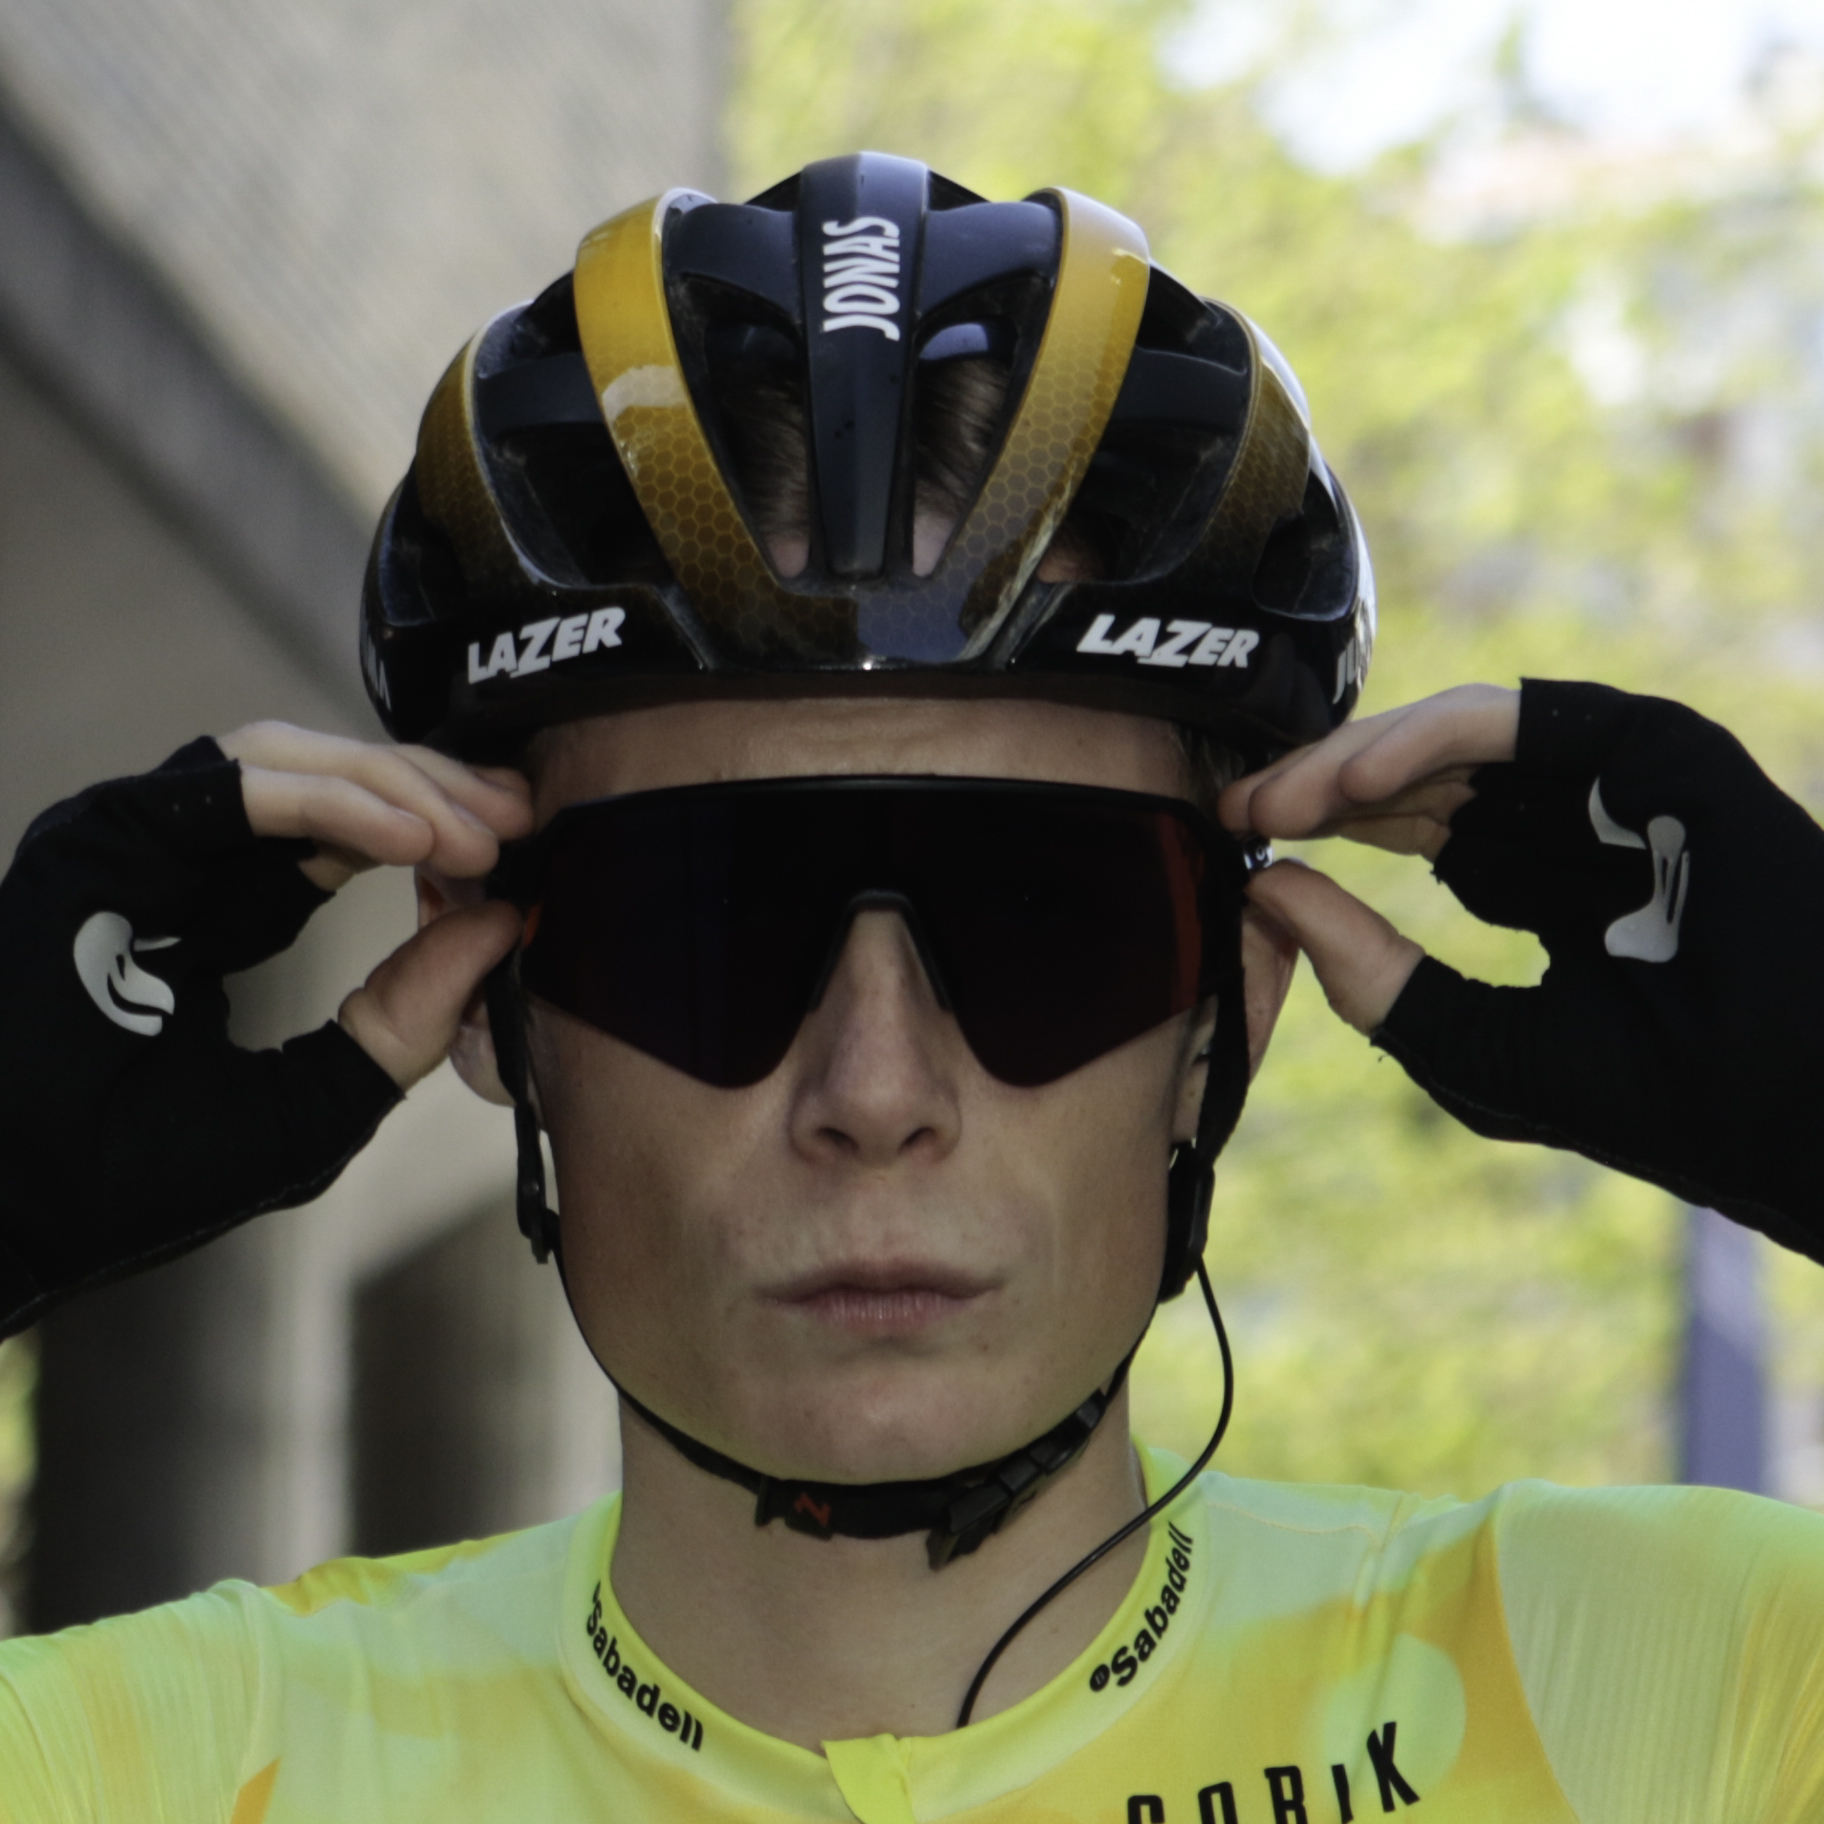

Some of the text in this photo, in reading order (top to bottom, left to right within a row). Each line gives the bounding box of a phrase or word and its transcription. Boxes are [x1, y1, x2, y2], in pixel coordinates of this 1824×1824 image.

[823, 216, 901, 341] JONAS
[468, 606, 626, 684] LAZER
[1077, 613, 1260, 668] LAZER
[1111, 1520, 1194, 1687] Sabadell
[586, 1599, 704, 1752] Sabadell
